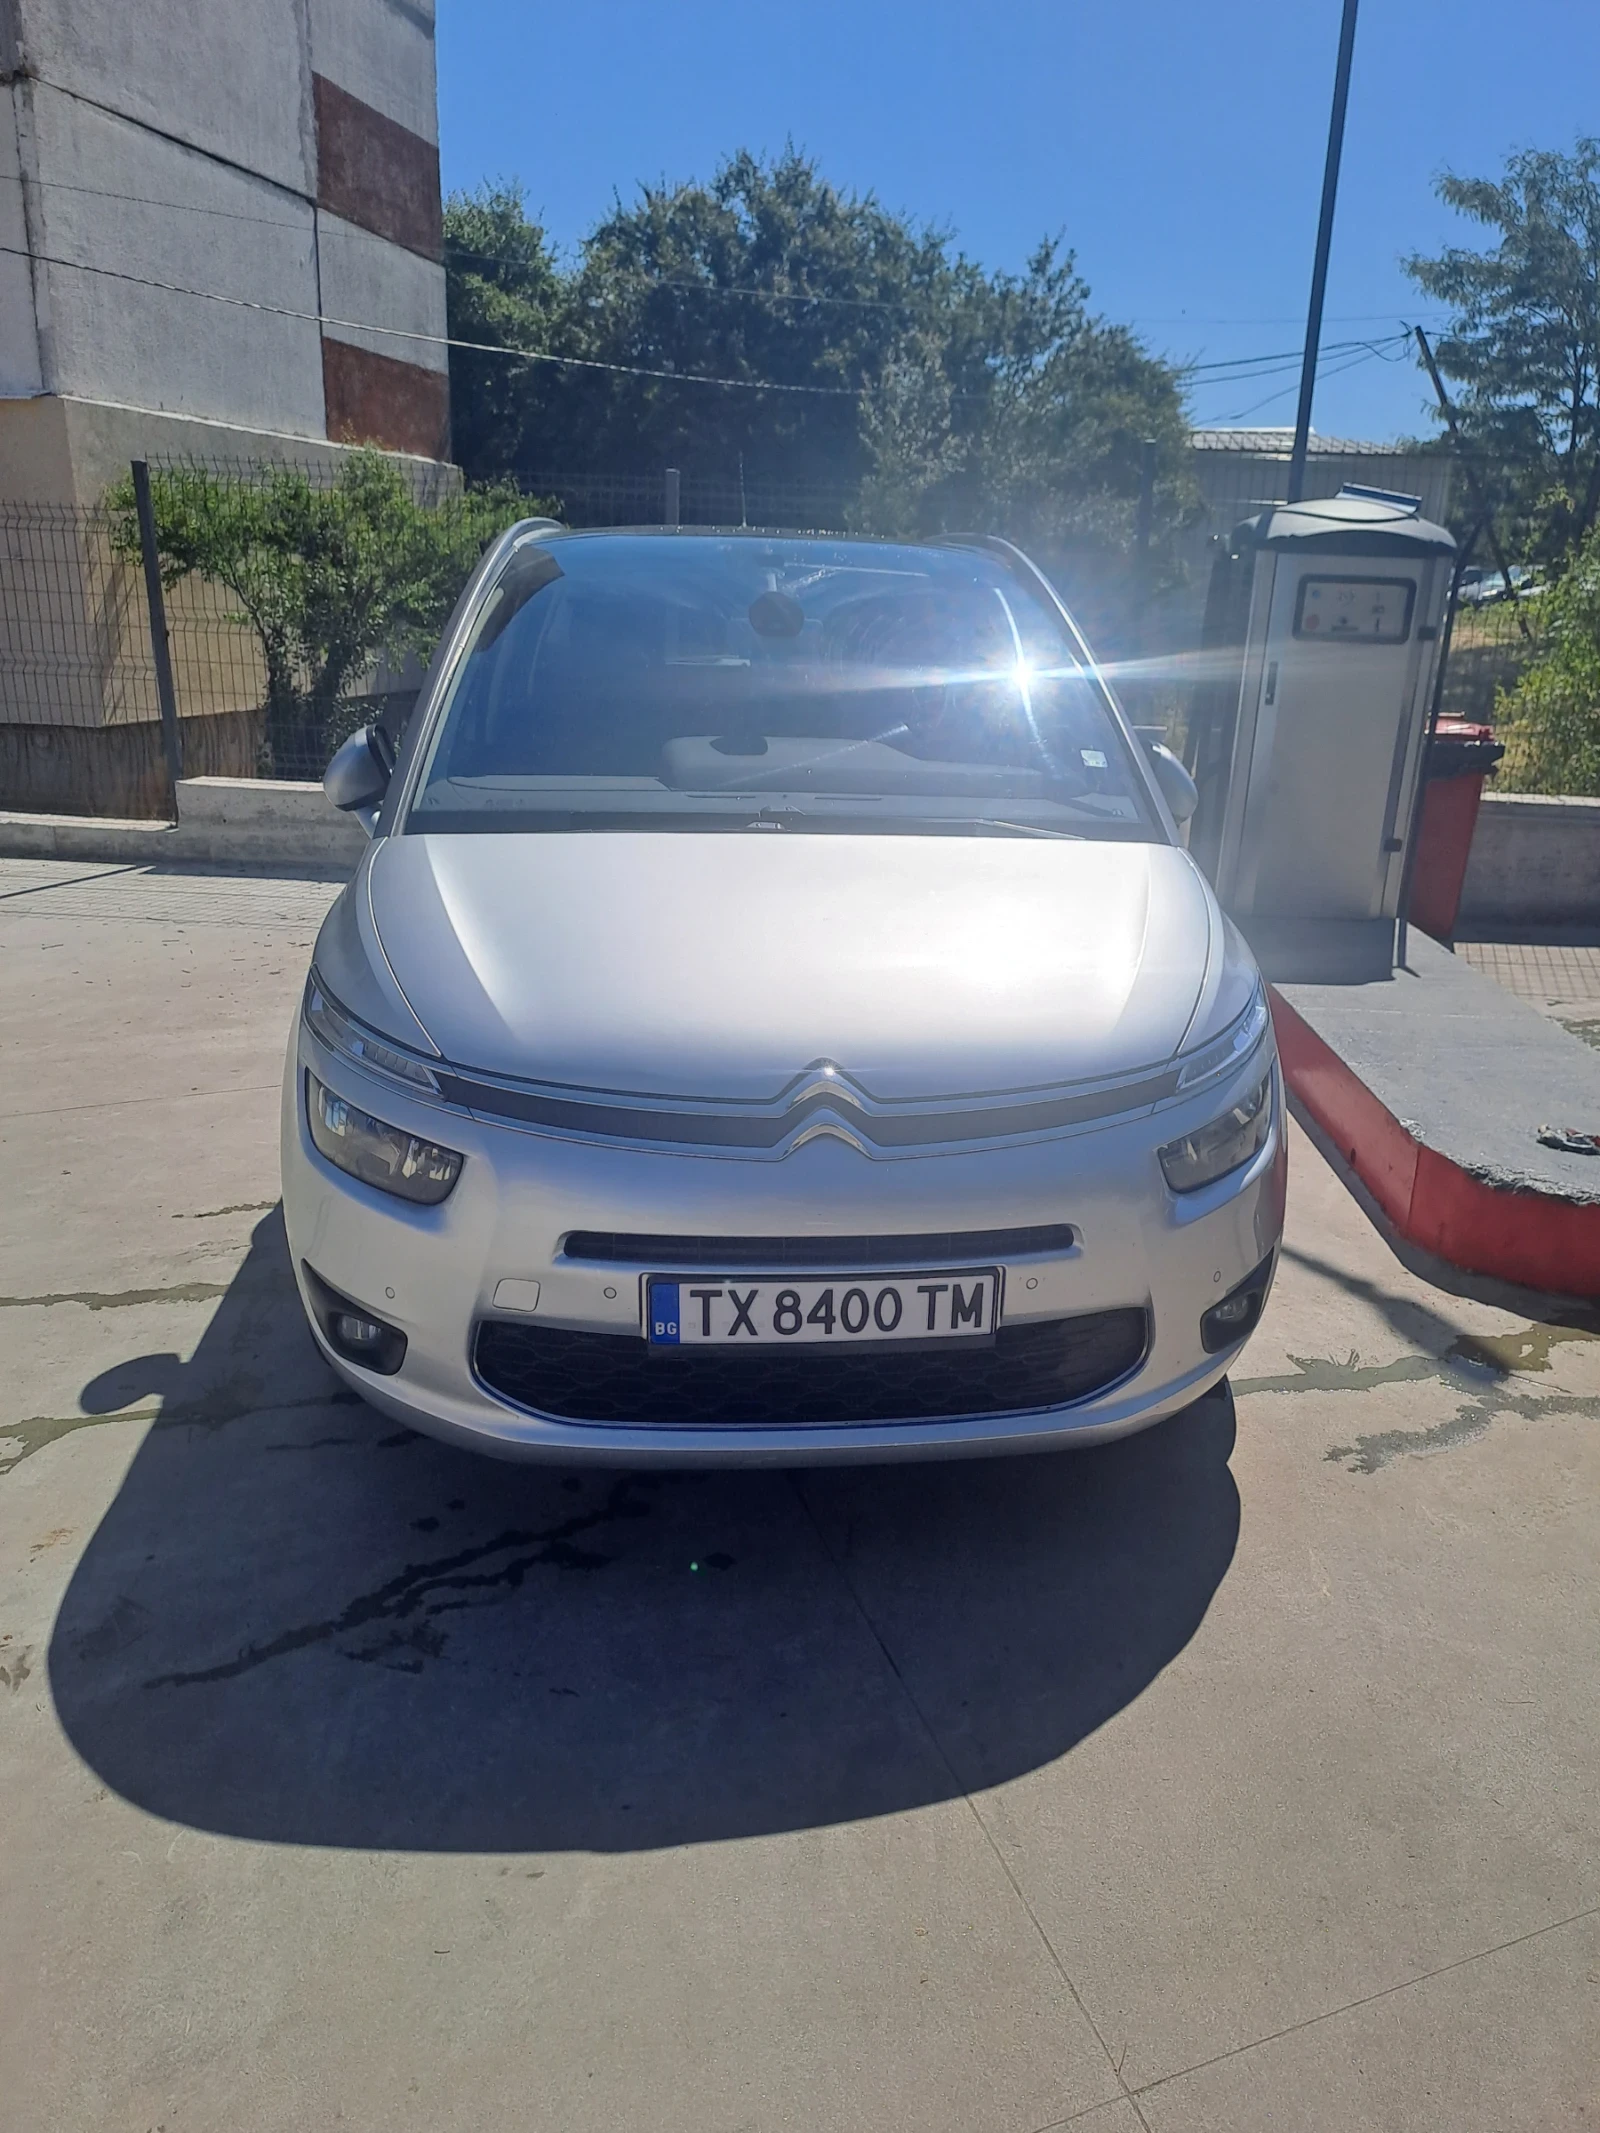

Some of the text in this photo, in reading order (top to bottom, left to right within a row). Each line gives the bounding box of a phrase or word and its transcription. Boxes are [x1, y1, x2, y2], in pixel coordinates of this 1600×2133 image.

[690, 1282, 984, 1336] TX 8400 TM
[655, 1322, 677, 1335] BG
